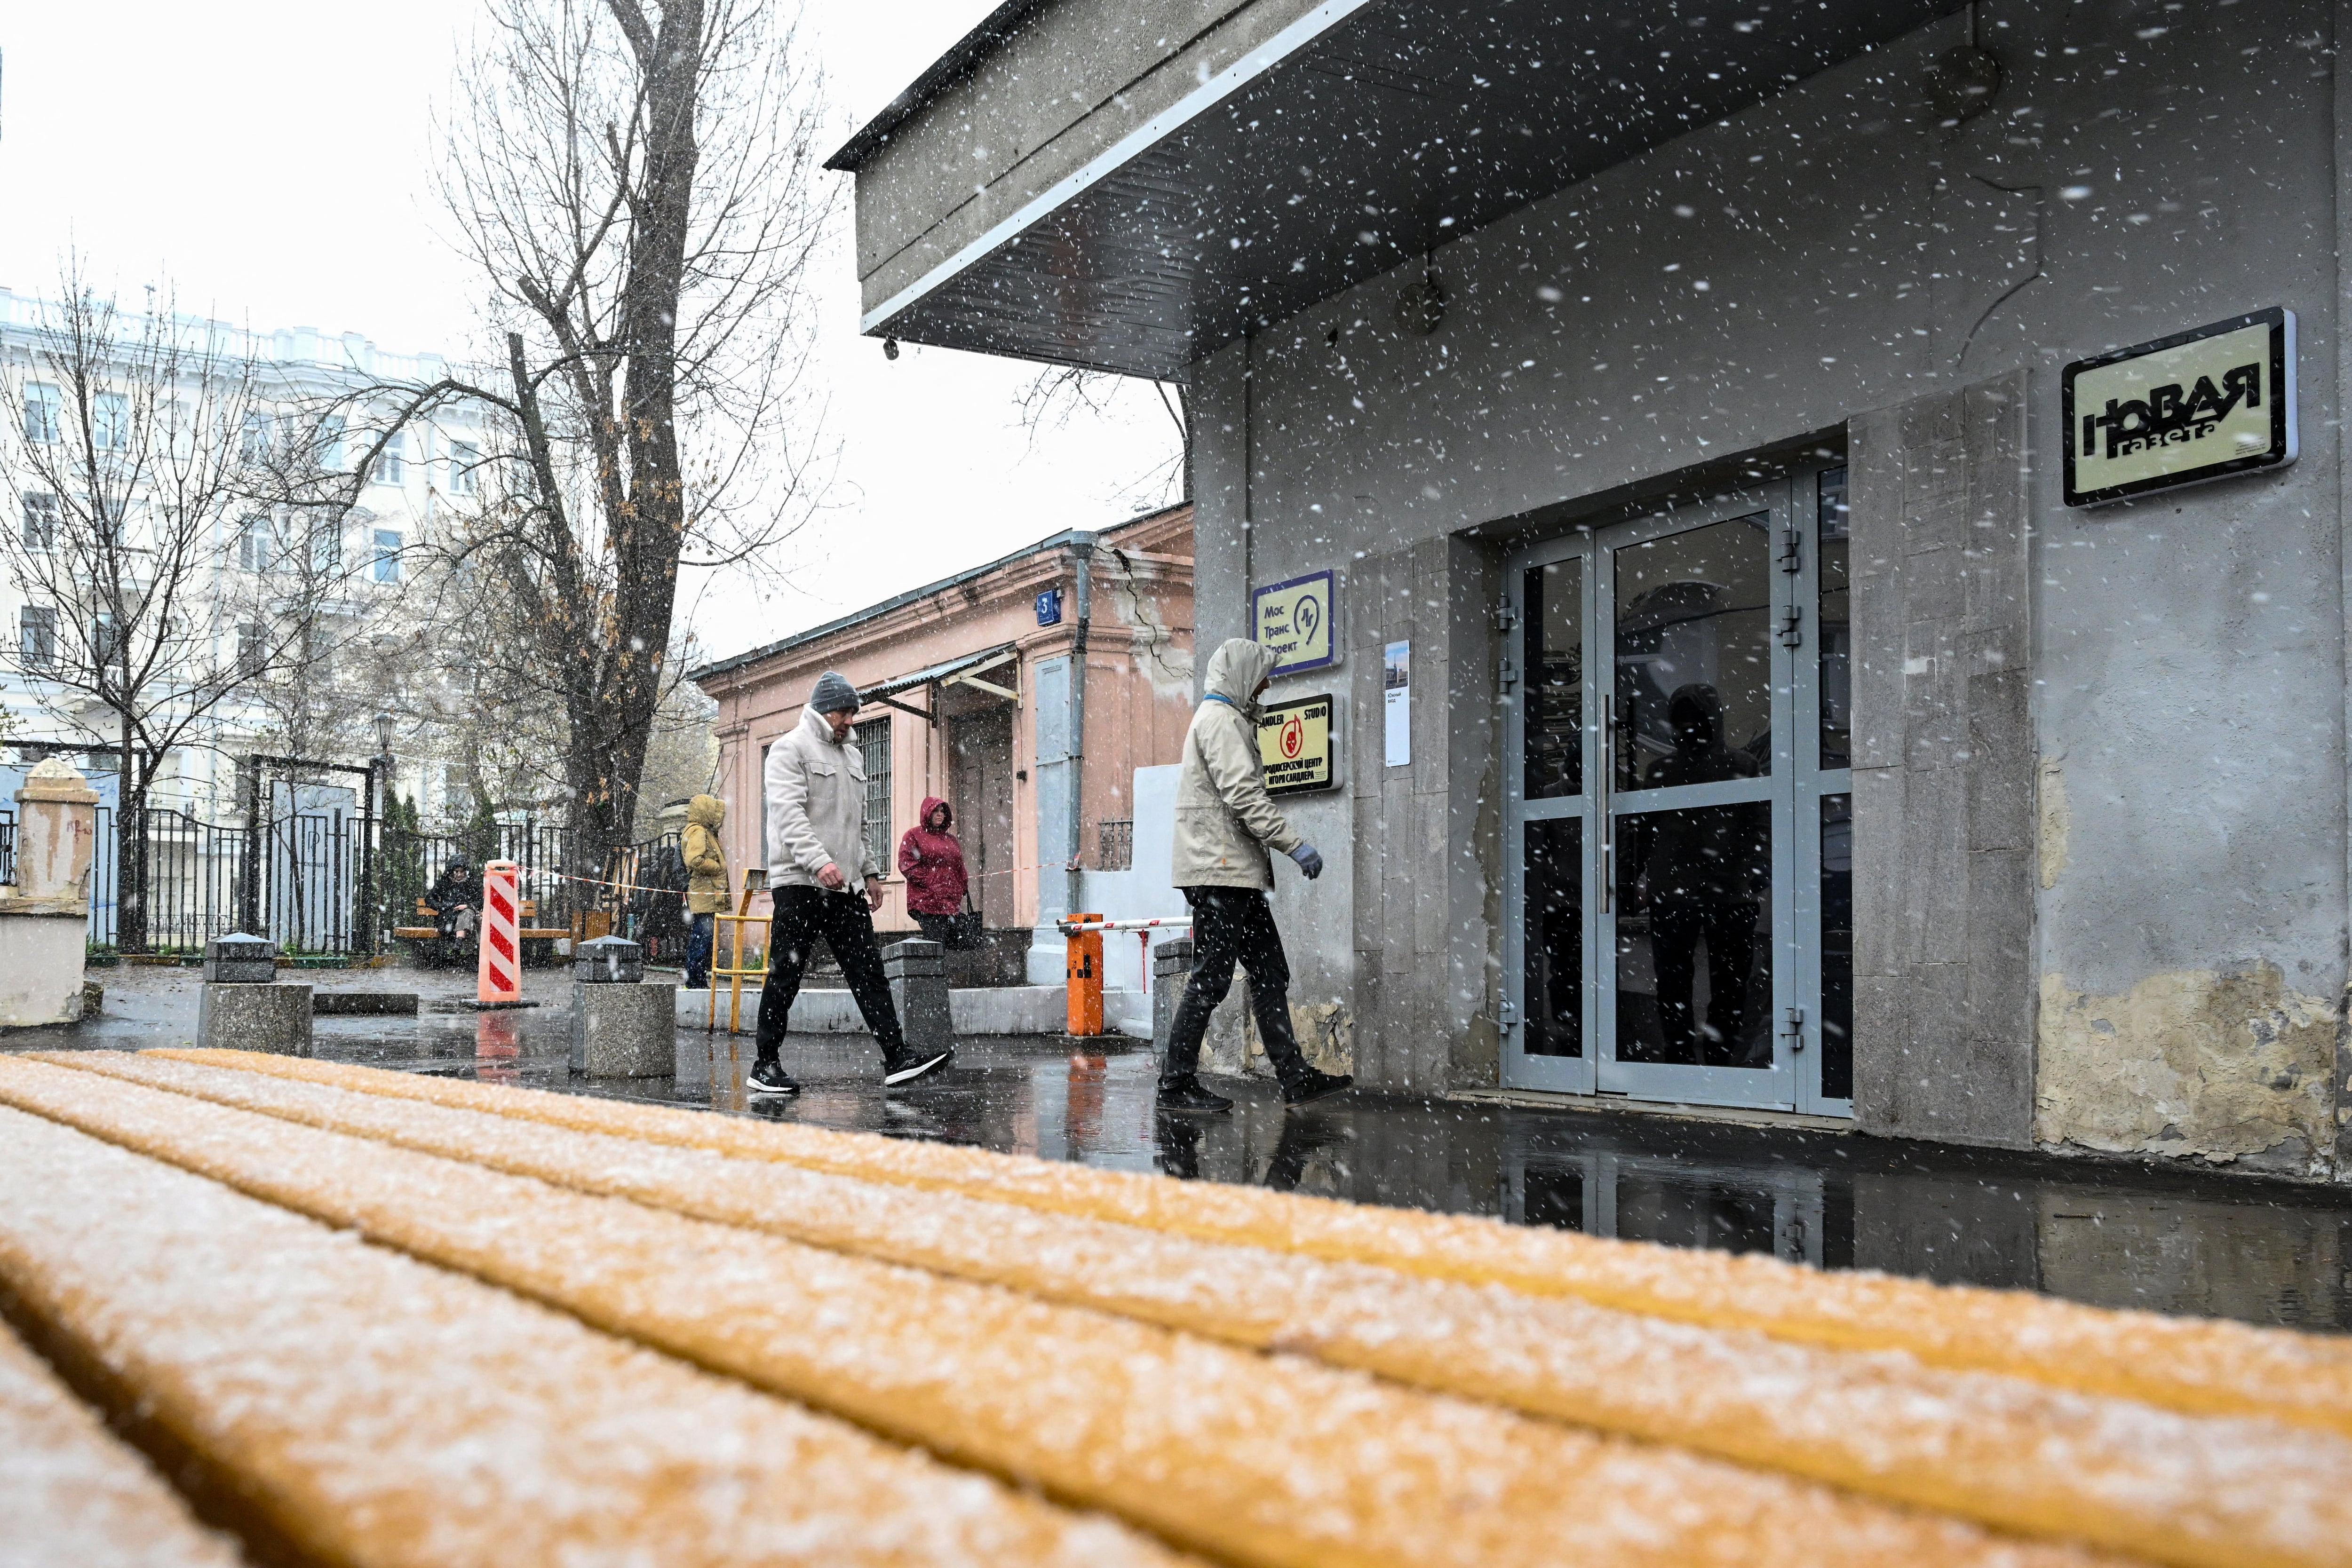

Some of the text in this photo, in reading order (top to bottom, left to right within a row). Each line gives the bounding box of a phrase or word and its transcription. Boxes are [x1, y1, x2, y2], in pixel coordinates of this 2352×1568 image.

[2083, 362, 2260, 459] НОВАЯ
[1041, 598, 1048, 614] 3
[1264, 606, 1284, 618] Мос
[1264, 624, 1289, 640] Транс
[1304, 706, 1327, 720] STUDIO
[1304, 757, 1322, 770] ЦЕНТР
[1269, 774, 1286, 785] ИГОРЯ
[1286, 770, 1314, 783] САНДЛЕРА
